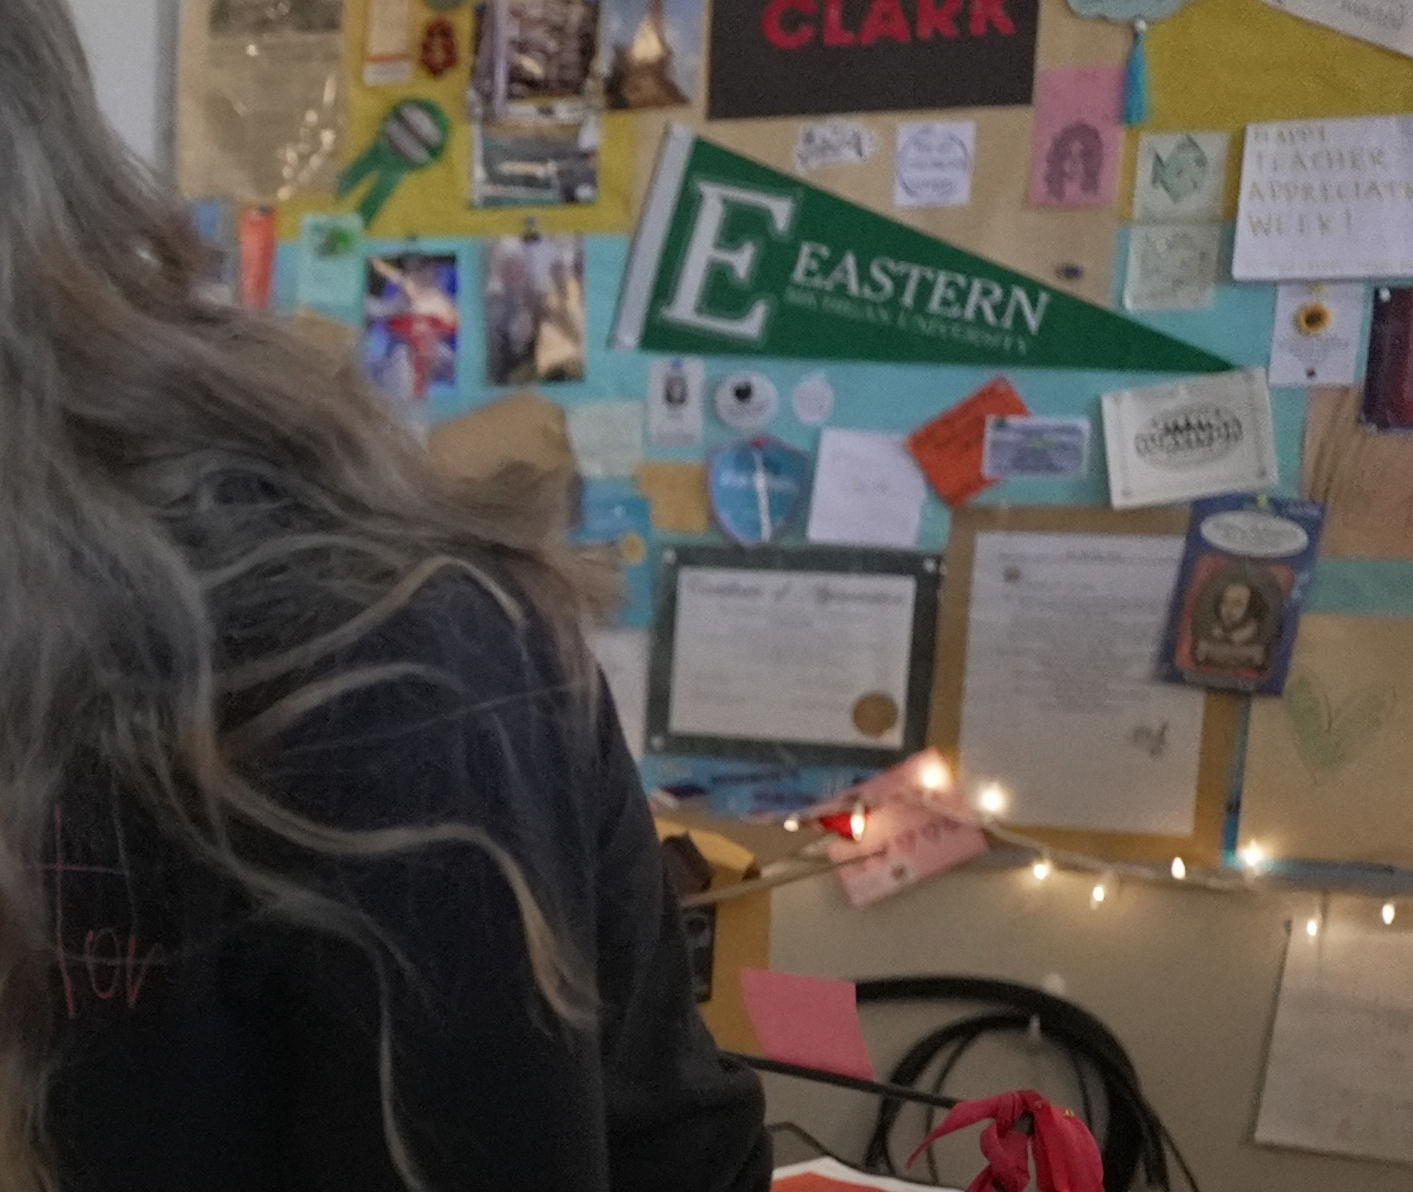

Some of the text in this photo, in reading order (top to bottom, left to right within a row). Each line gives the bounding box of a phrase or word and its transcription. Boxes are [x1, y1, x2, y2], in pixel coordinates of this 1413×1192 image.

[761, 0, 1016, 50] CLARK
[663, 181, 794, 338] E
[791, 241, 1050, 335] EASTERN
